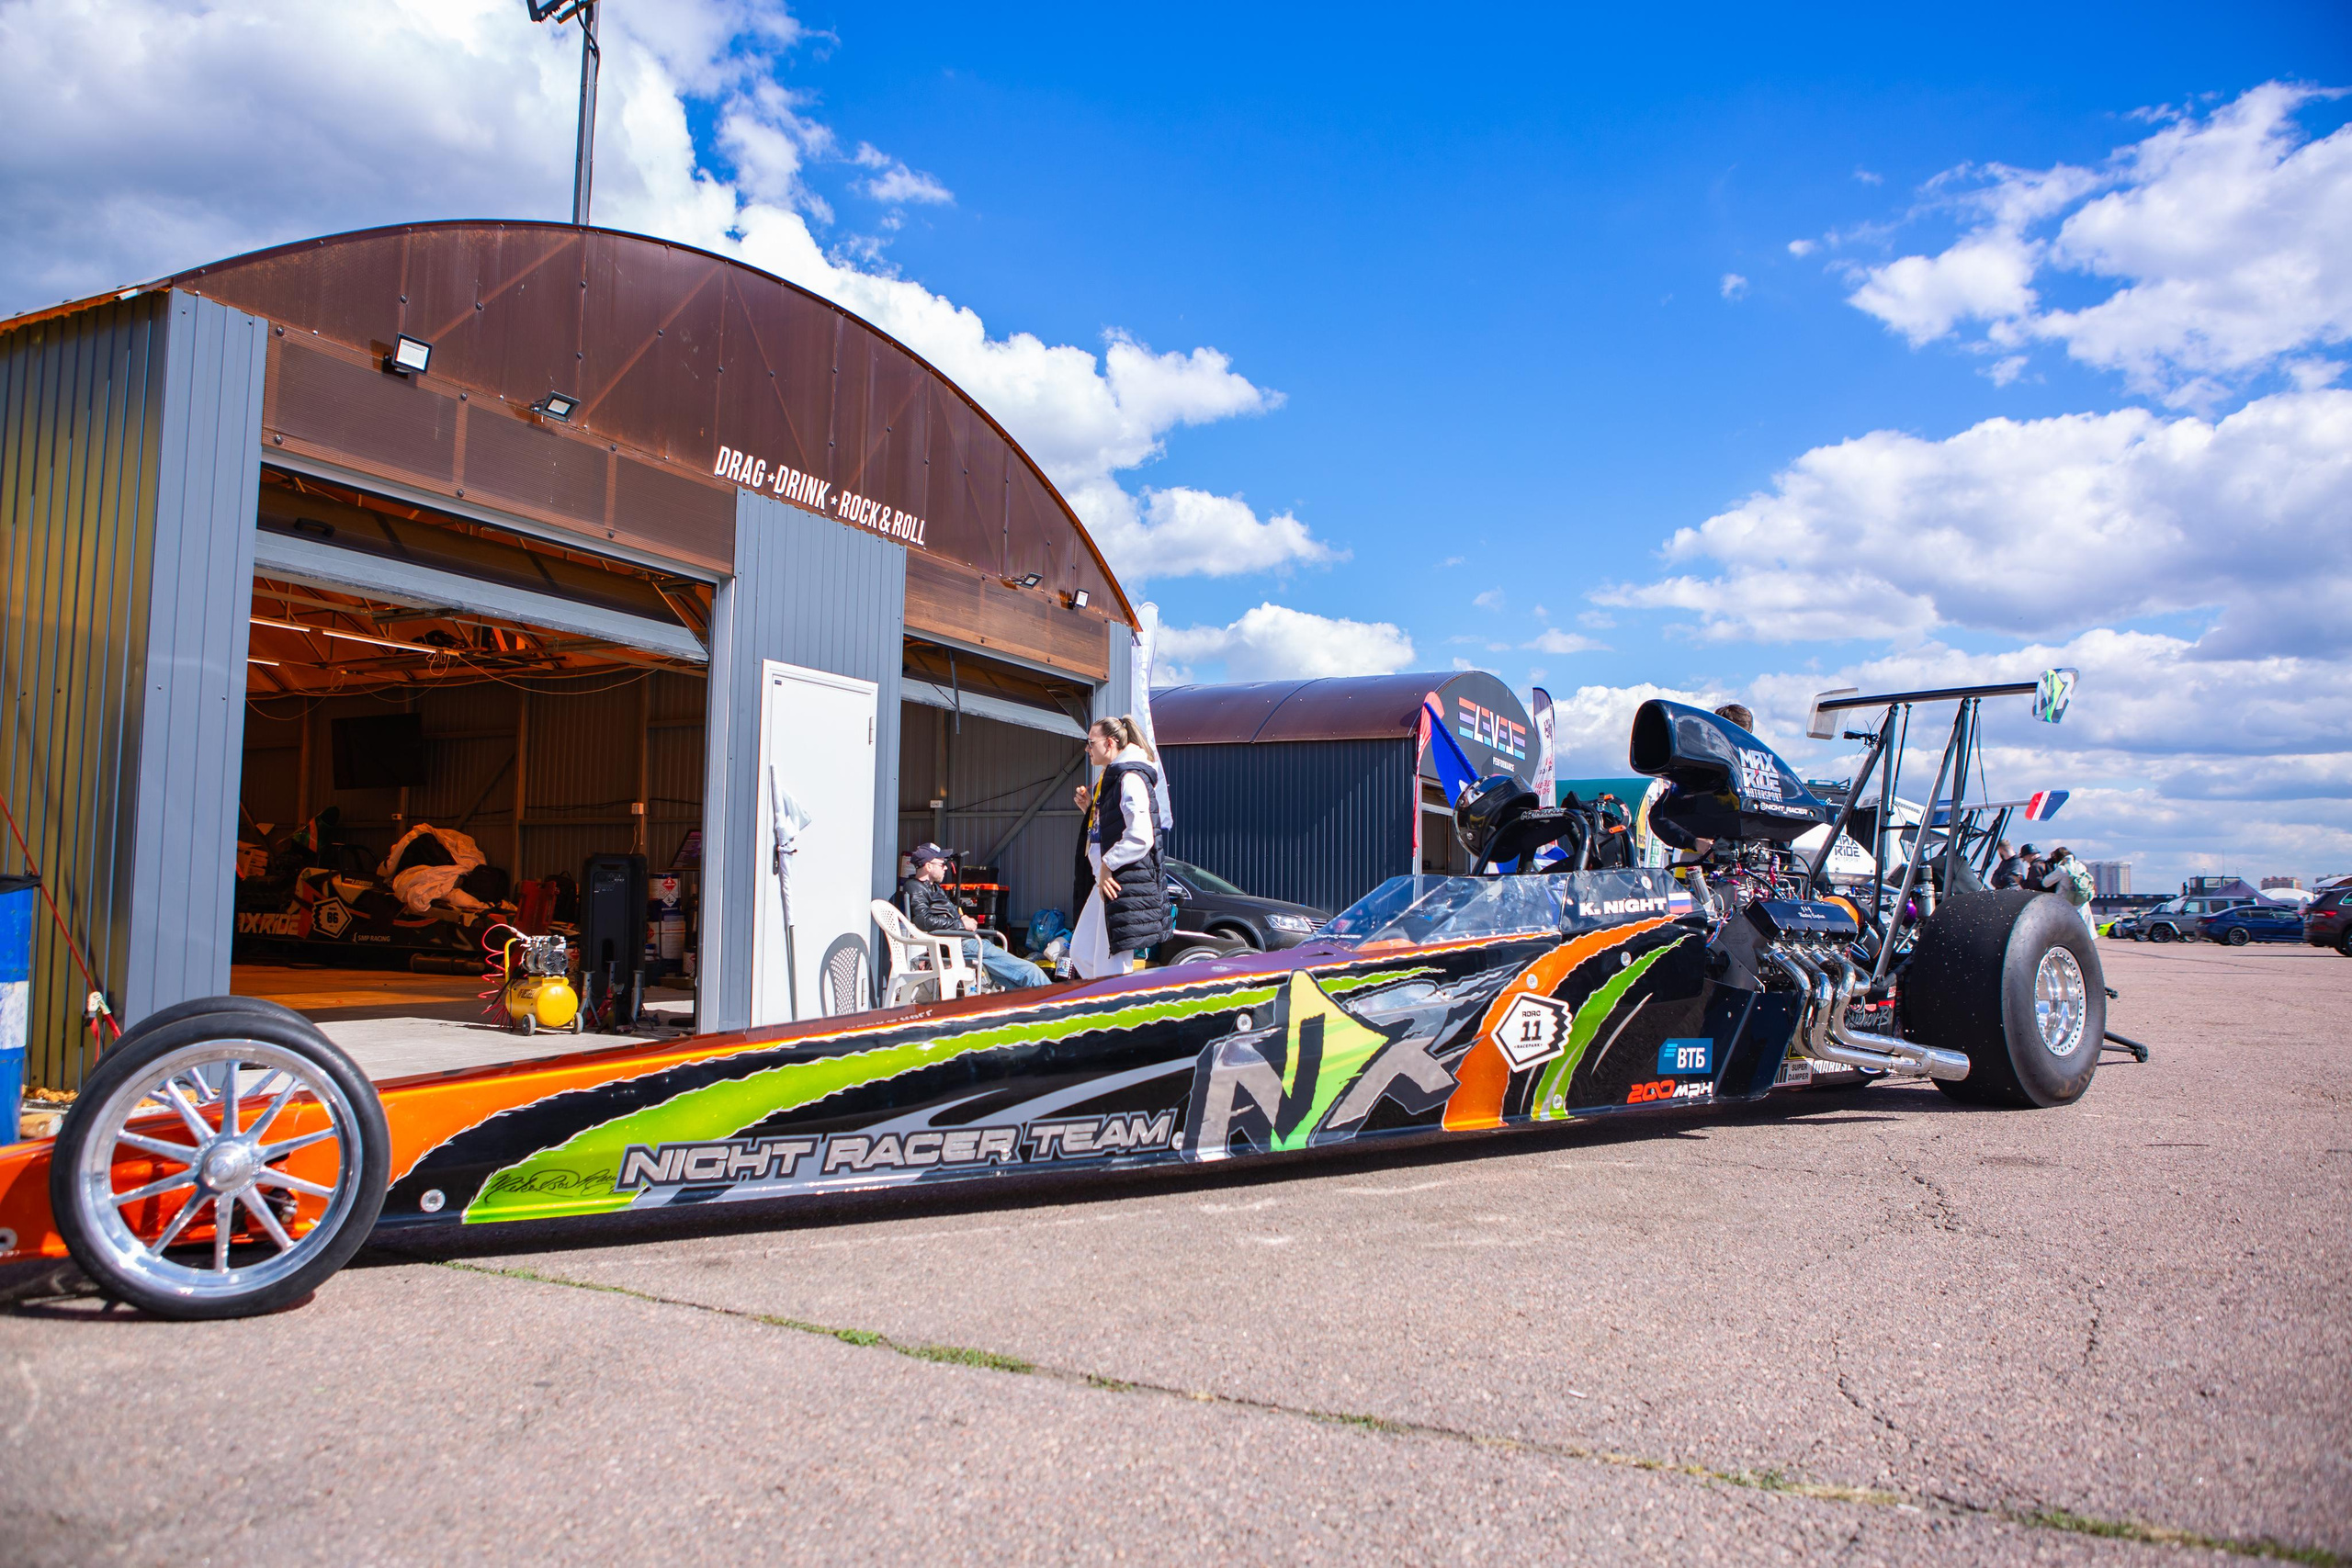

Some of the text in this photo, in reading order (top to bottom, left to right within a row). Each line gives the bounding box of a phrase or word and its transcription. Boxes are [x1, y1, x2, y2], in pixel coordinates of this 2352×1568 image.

[714, 446, 766, 488] DRAG
[773, 464, 831, 510] DRINK
[1738, 747, 1778, 773] MAX
[1745, 787, 1782, 803] MOTORSPORT
[1760, 802, 1809, 815] @NIGHT_RACER
[1578, 897, 1668, 917] K. NIGHT
[327, 911, 339, 923] 86
[370, 934, 390, 942] RACING
[1521, 1020, 1542, 1042] 11
[1677, 1047, 1706, 1069] ВТБ
[1792, 1063, 1808, 1071] SUPER
[1788, 1073, 1809, 1081] DAMPER
[625, 1115, 1171, 1183] NIGHT RACER TEAM
